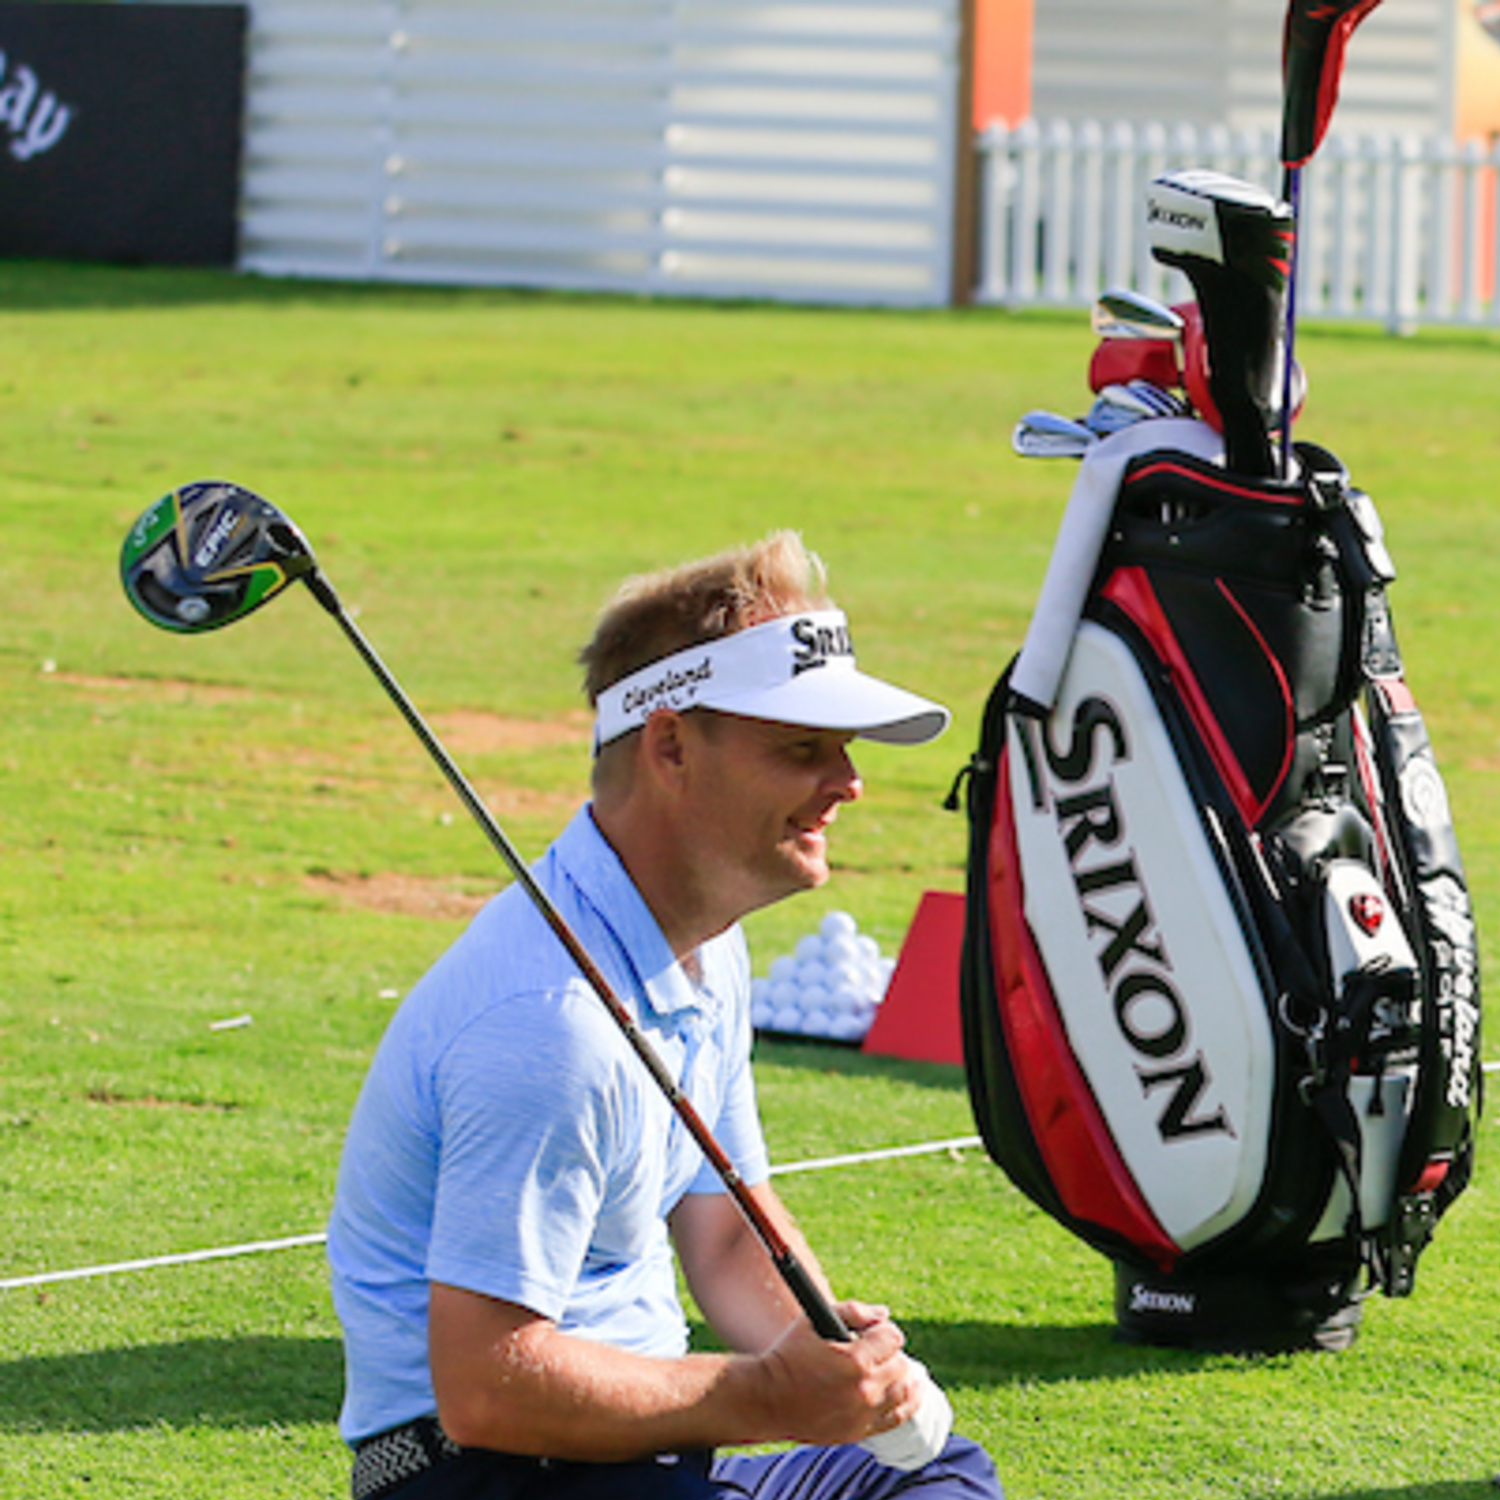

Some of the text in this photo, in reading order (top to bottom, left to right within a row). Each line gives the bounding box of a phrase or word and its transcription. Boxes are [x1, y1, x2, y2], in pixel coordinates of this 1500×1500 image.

[0, 50, 71, 159] ay
[194, 509, 240, 568] EPIC
[622, 656, 713, 714] Cleveland
[1035, 694, 1238, 1145] SRIXON
